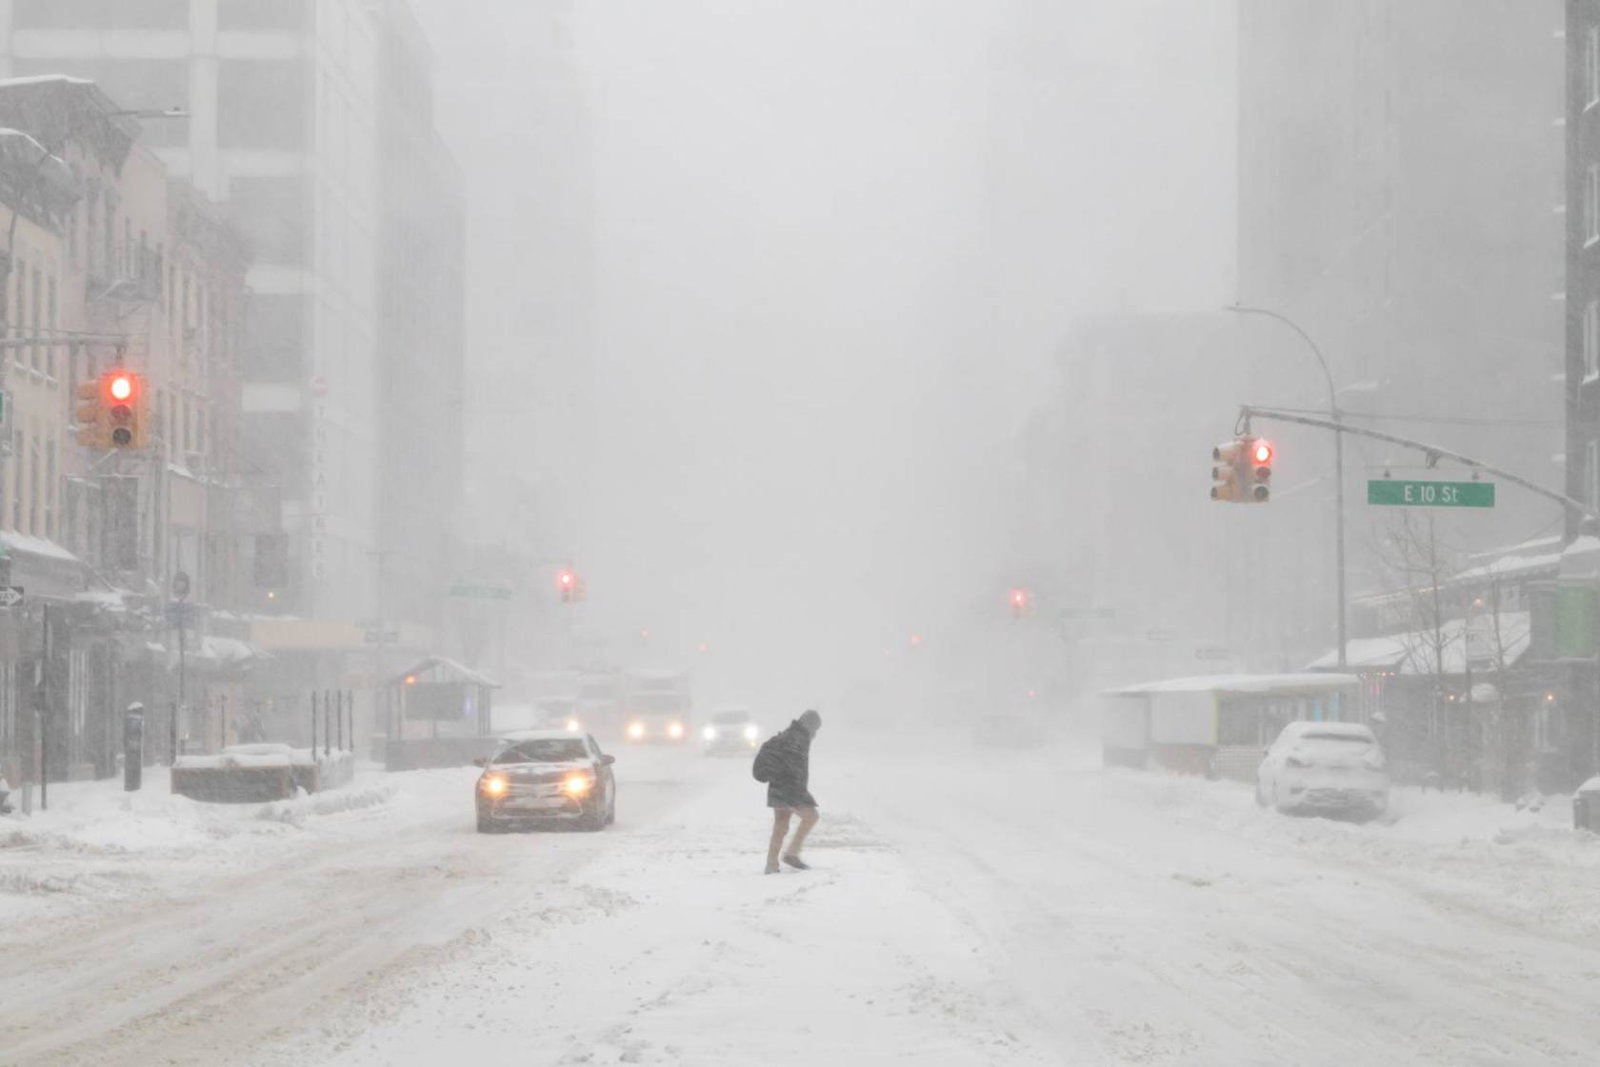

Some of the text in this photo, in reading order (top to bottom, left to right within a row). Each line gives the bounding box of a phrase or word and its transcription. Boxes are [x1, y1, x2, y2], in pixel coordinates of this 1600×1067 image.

[1404, 485, 1458, 503] E 10 St
